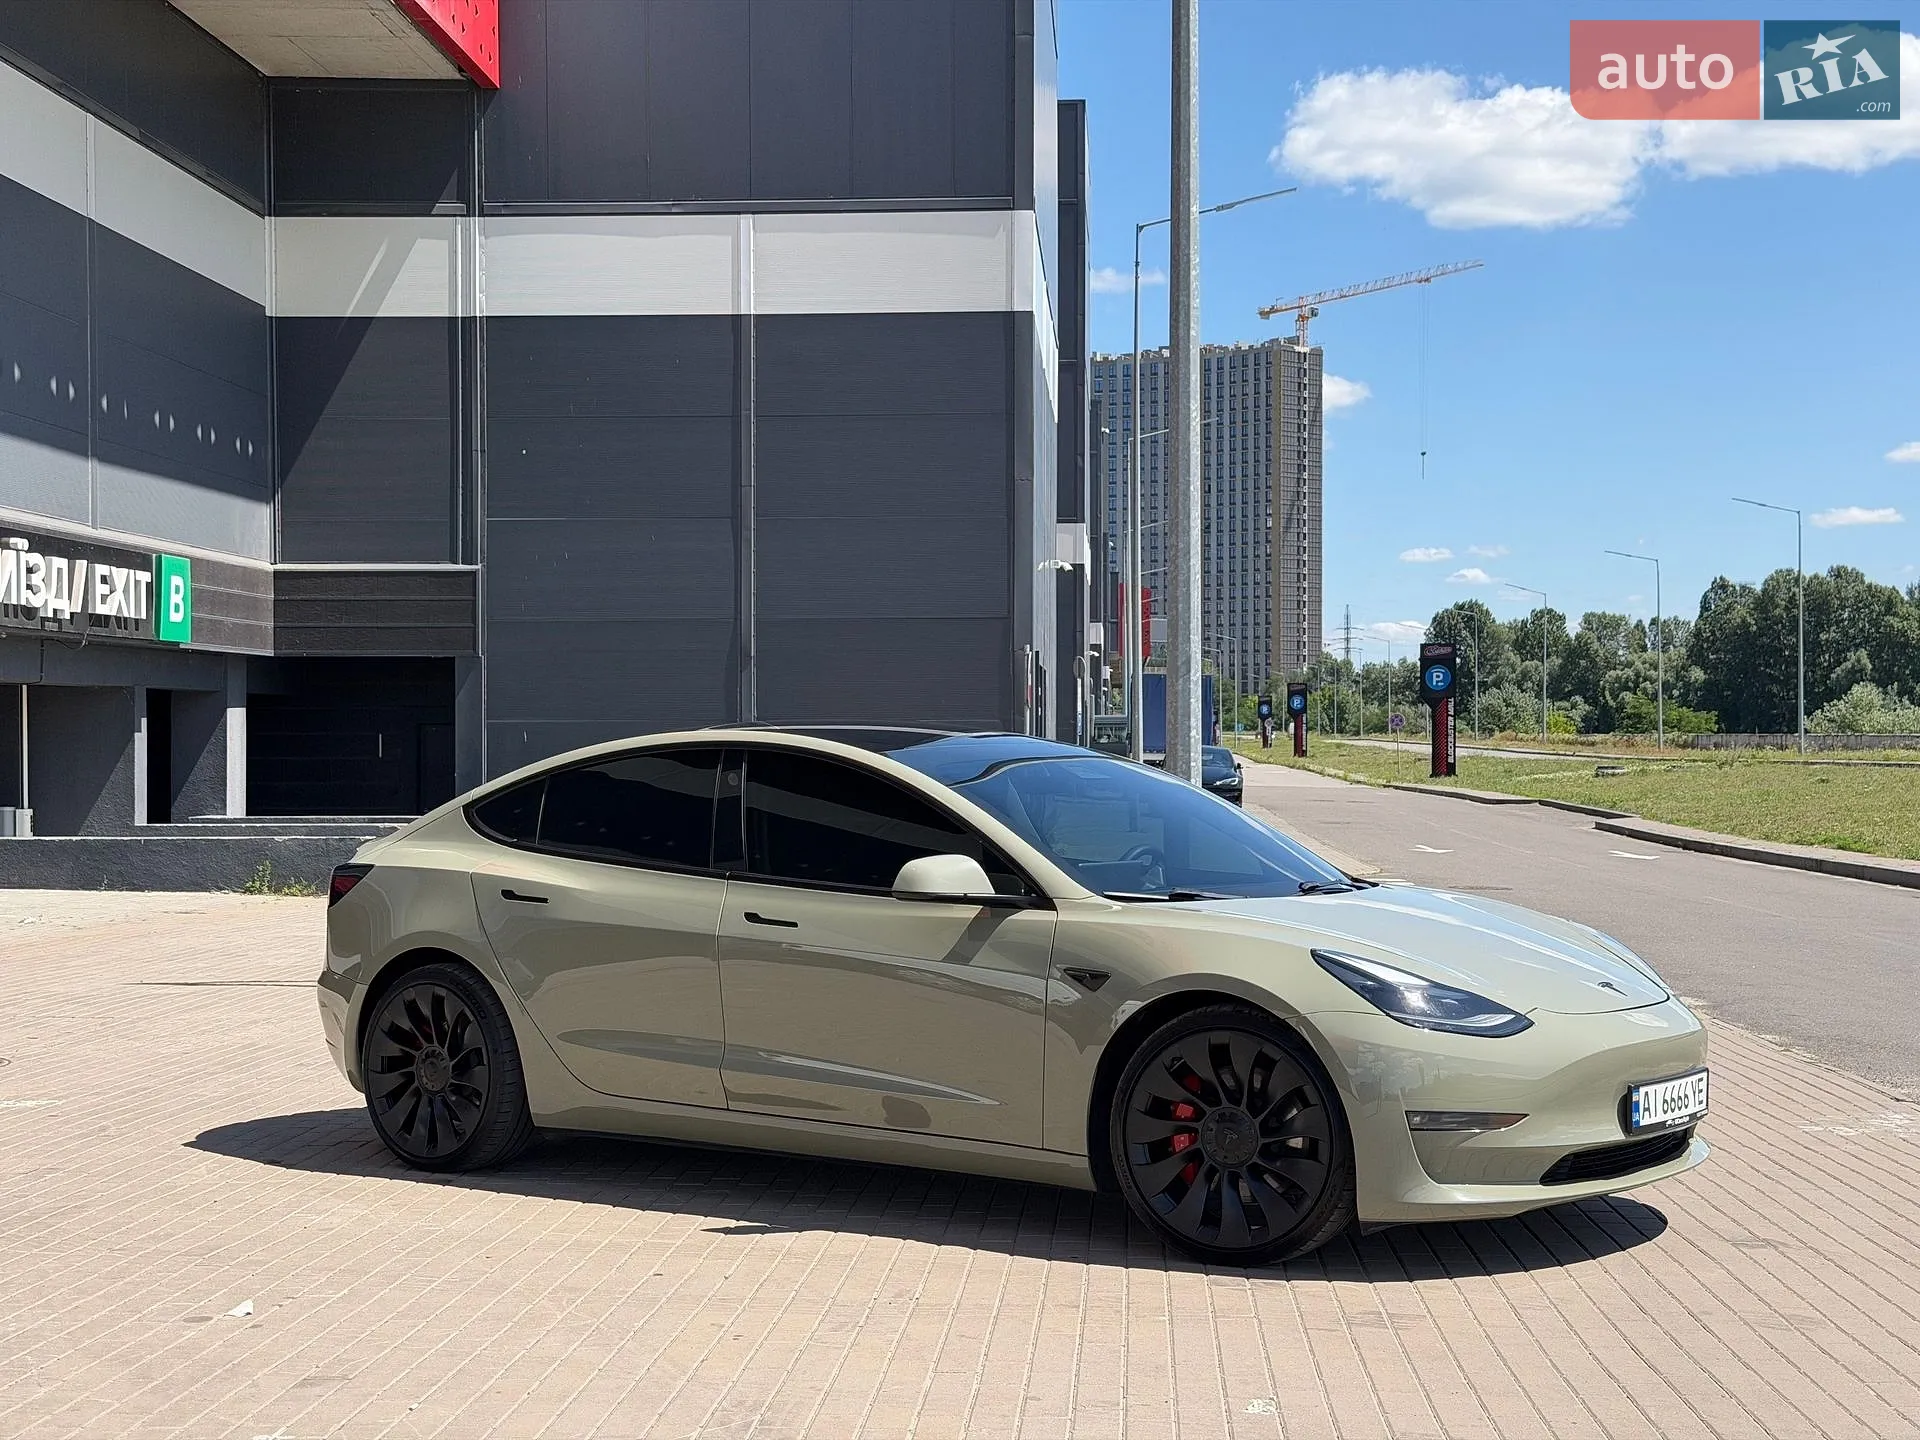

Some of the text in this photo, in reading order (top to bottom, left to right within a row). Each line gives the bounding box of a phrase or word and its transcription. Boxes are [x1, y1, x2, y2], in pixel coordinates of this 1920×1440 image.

[89, 563, 151, 619] EXIT
[169, 575, 185, 623] B
[1432, 671, 1443, 686] P
[1642, 1077, 1704, 1120] AI 6666 YE
